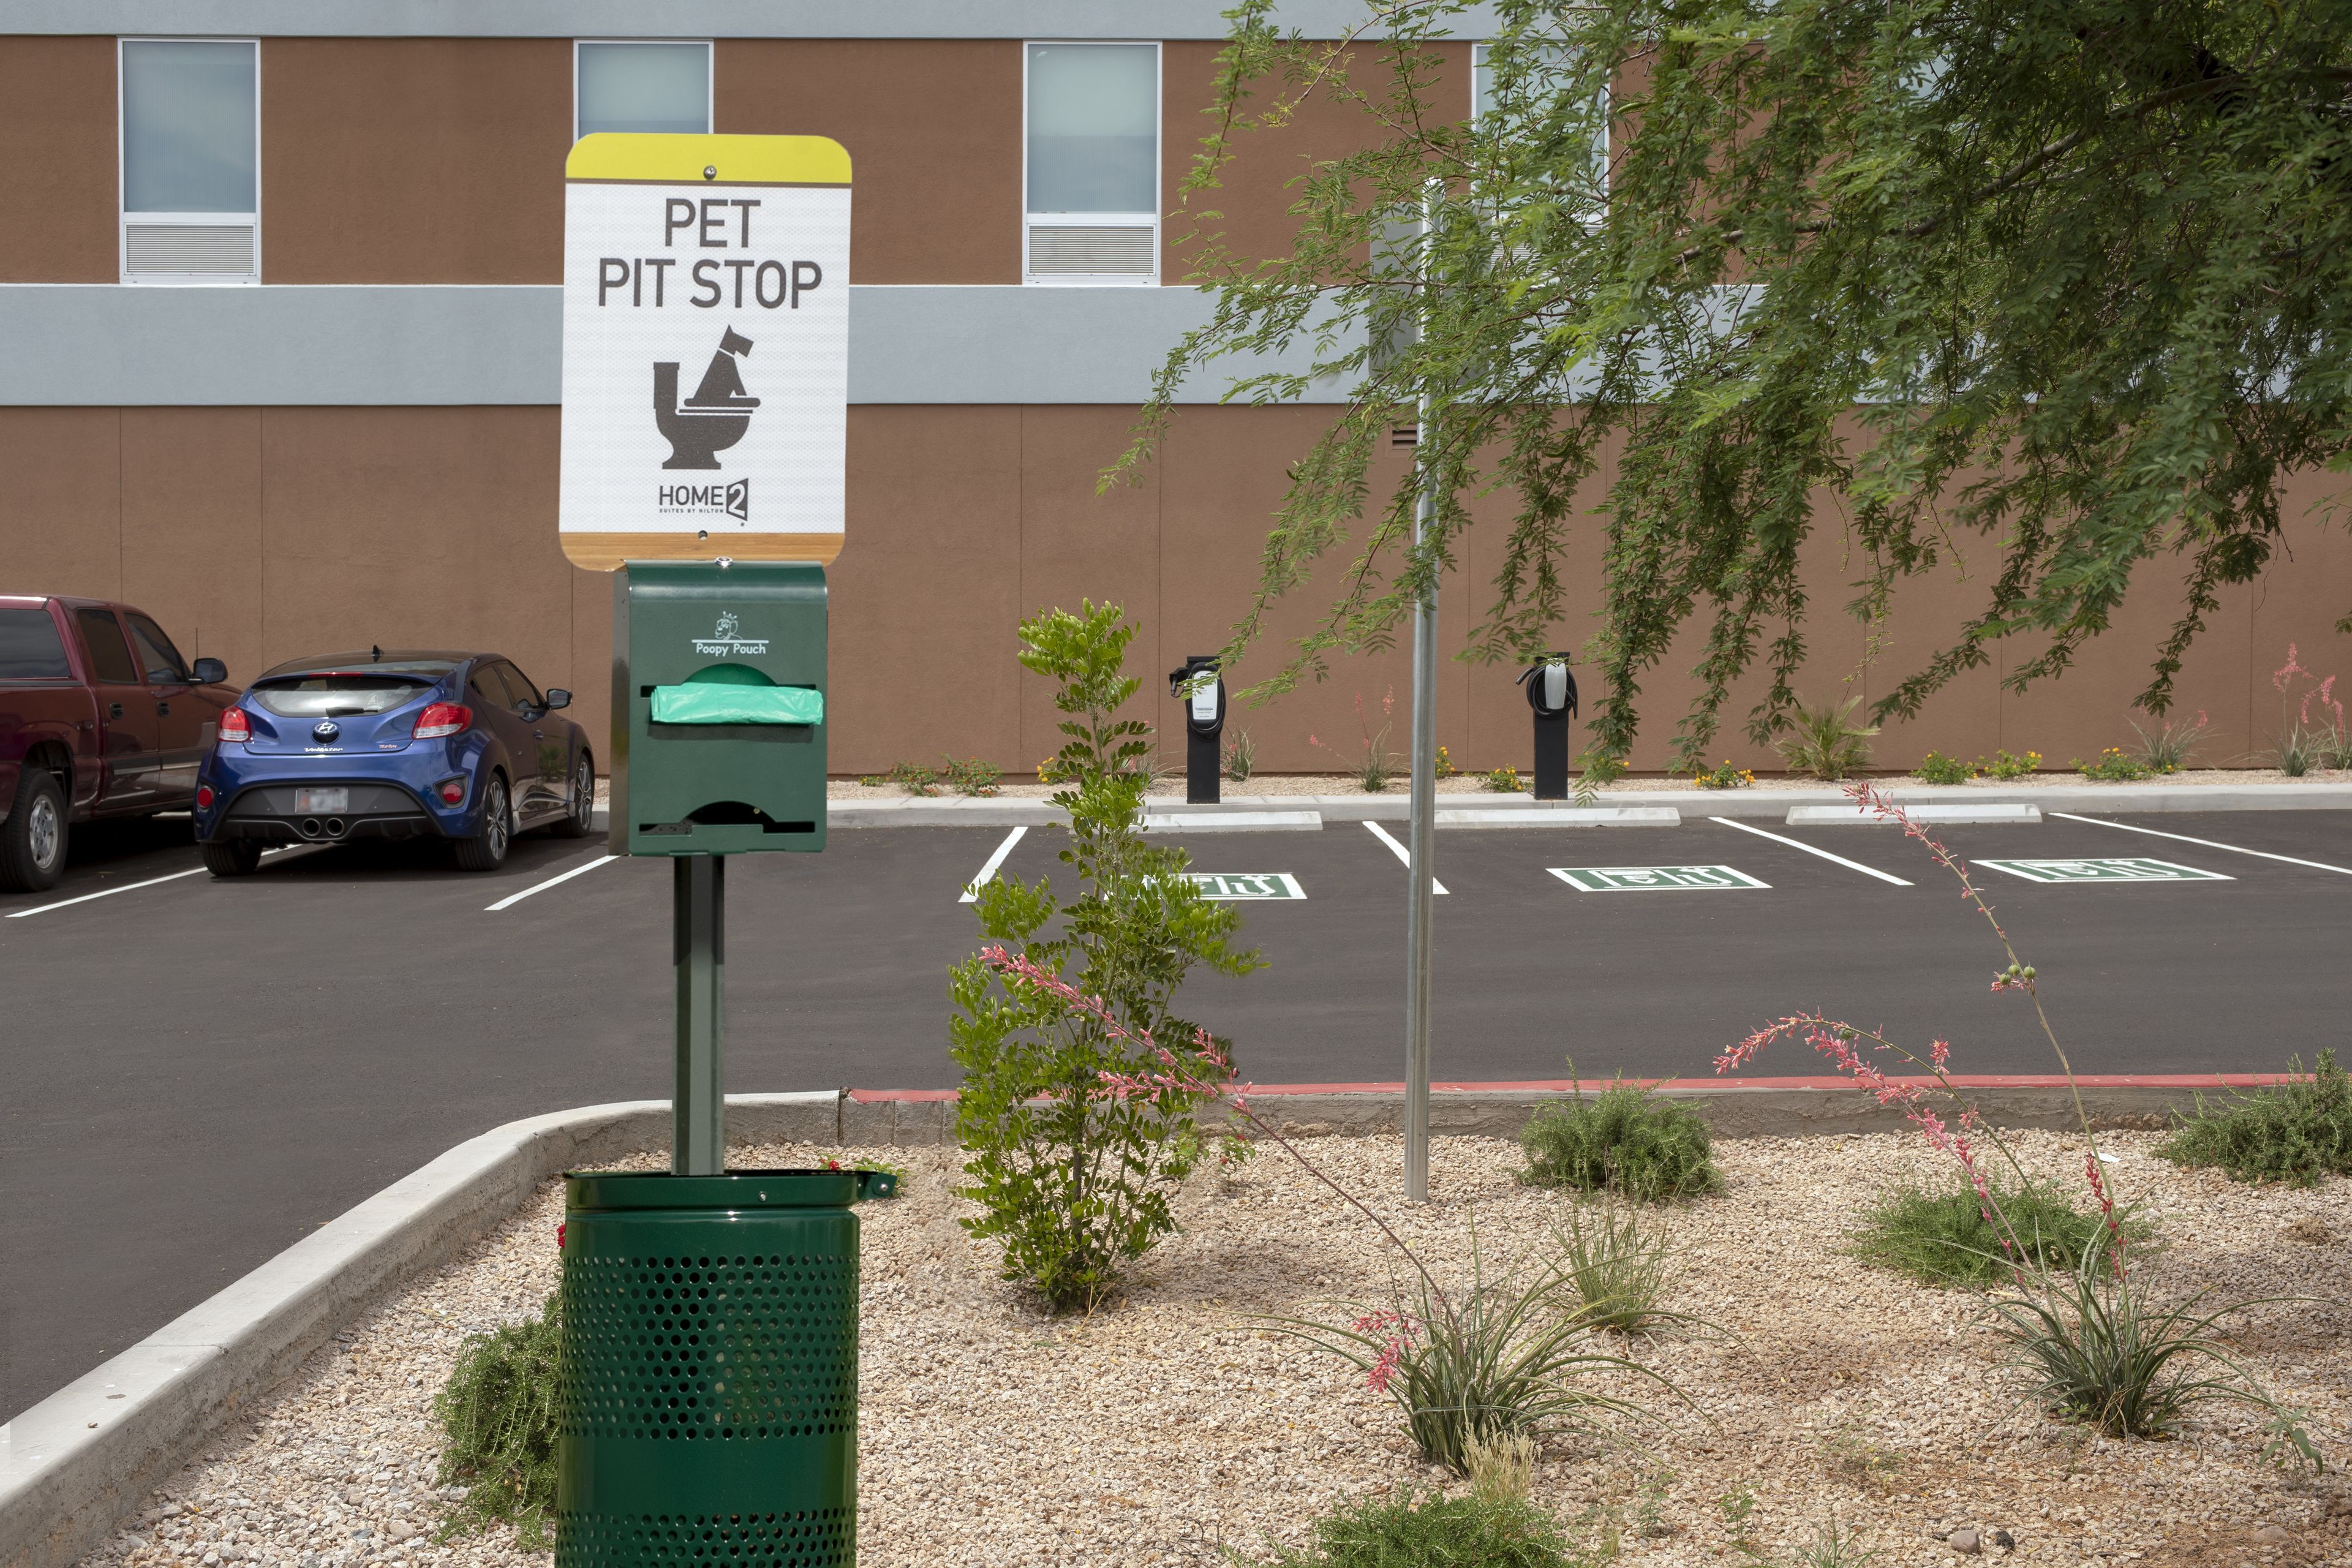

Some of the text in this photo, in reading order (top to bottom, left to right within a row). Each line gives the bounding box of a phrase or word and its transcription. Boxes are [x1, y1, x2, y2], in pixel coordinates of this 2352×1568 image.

[665, 198, 761, 248] PET
[598, 258, 823, 309] PIT STOP
[696, 643, 766, 657] Poopy Pouch
